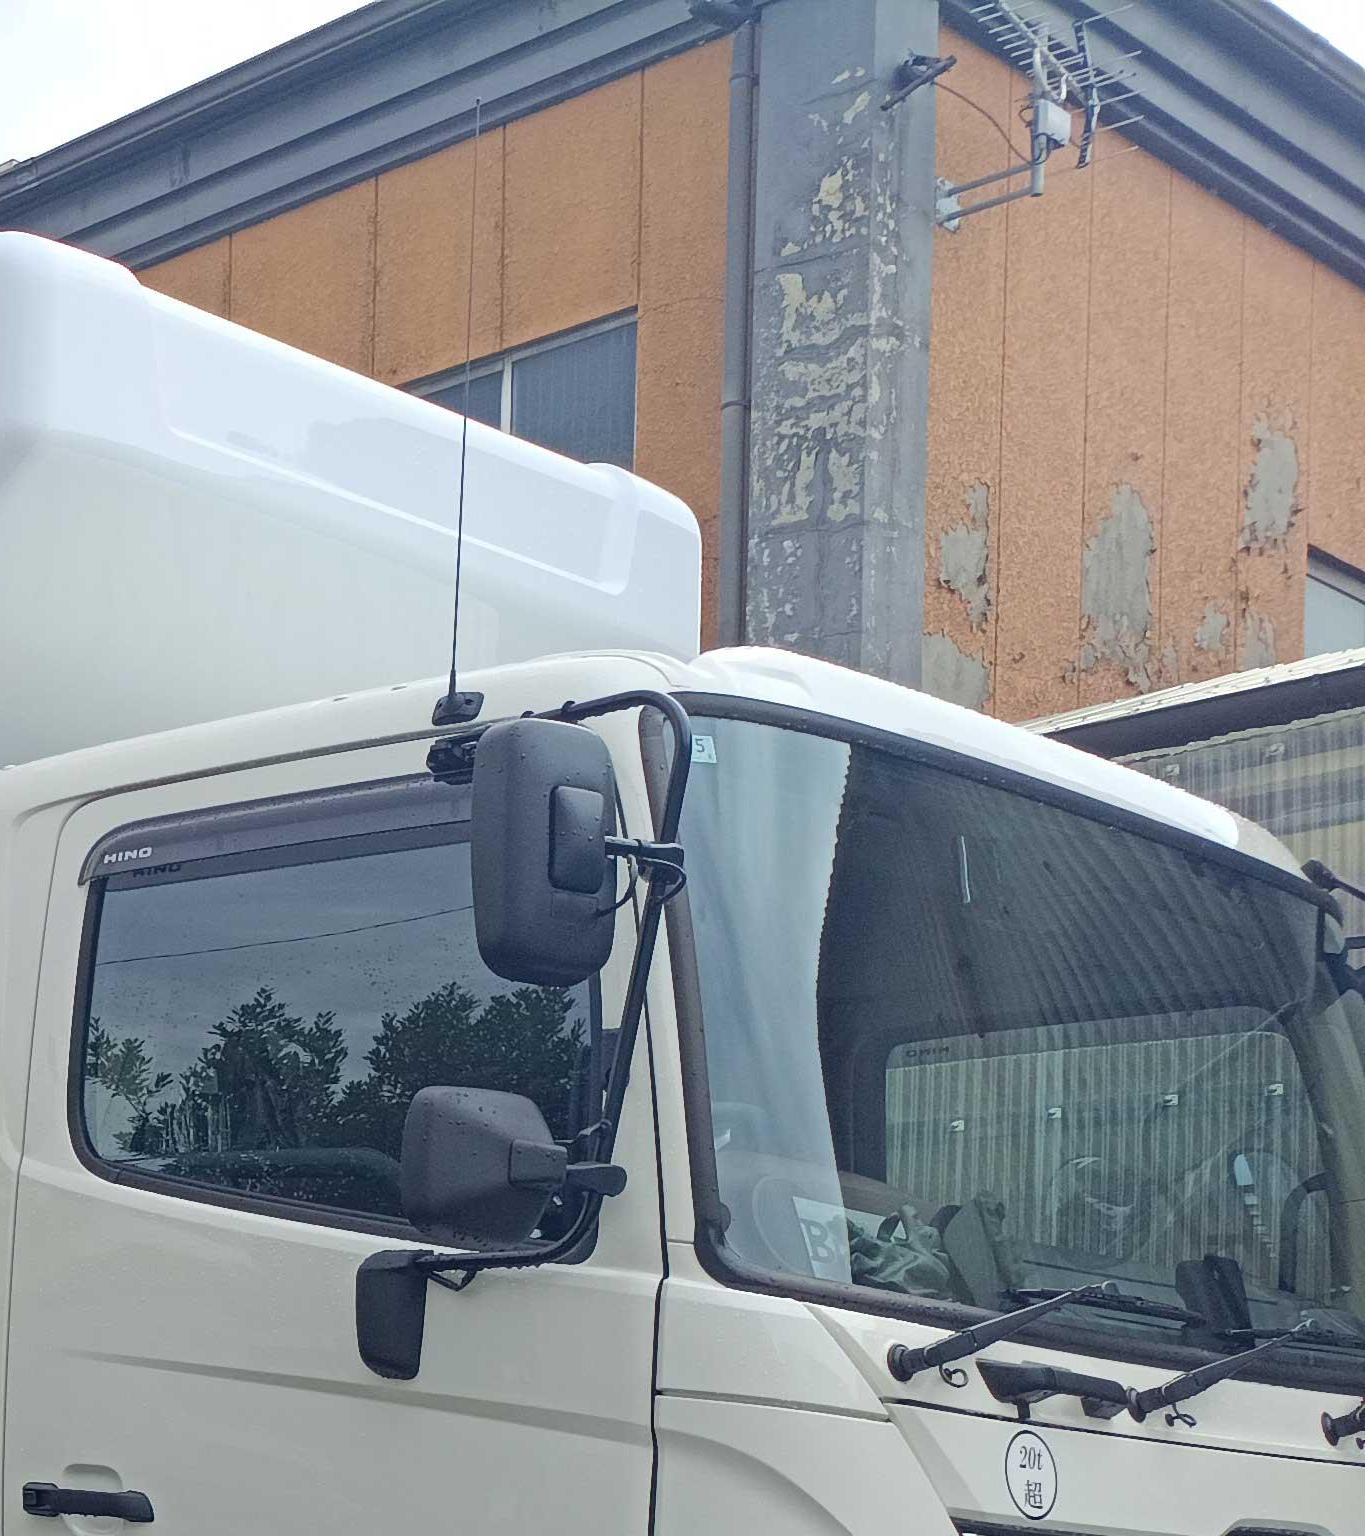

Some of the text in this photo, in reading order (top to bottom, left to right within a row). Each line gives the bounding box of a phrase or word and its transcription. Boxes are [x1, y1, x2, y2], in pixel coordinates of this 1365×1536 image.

[103, 846, 153, 865] HINO
[1019, 1445, 1043, 1471] 20t
[1023, 1479, 1044, 1510] 超
